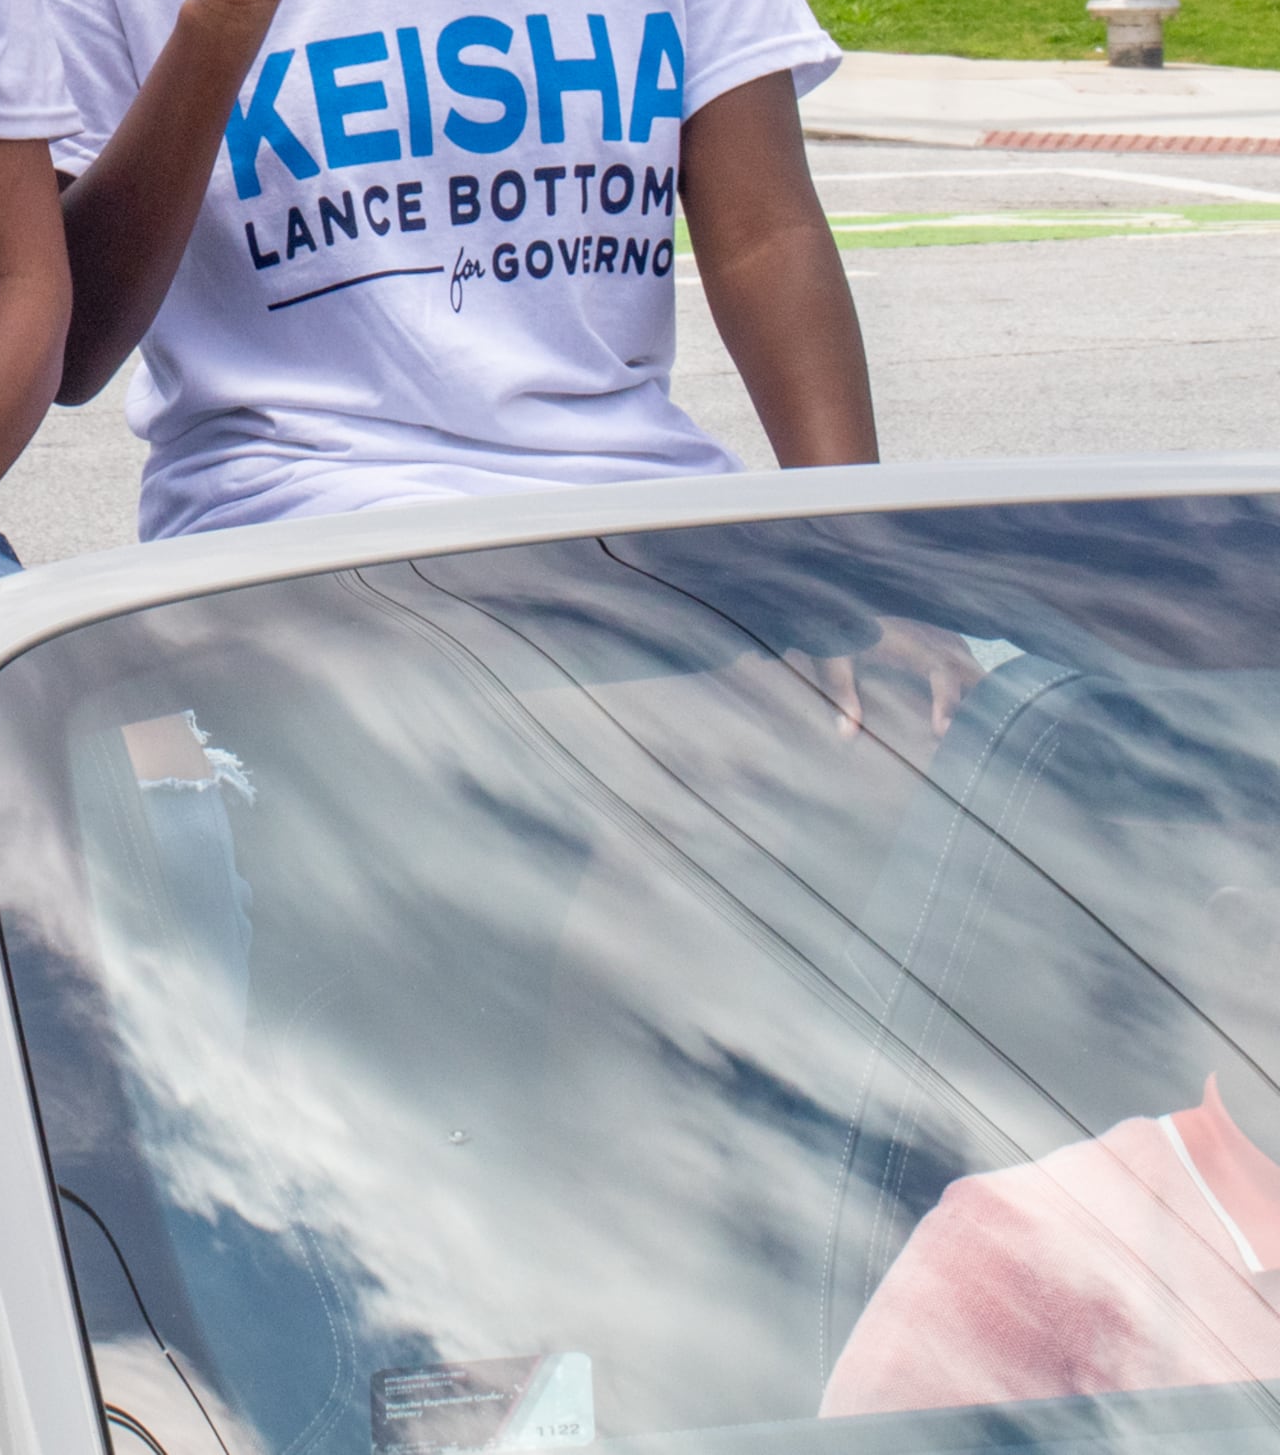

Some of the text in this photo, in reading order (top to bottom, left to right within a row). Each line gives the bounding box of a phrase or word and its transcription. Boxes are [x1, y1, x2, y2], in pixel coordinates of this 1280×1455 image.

[225, 11, 685, 200] KEISHA
[244, 180, 427, 270] LANCE
[450, 246, 486, 312] for
[536, 1423, 581, 1437] 1122
